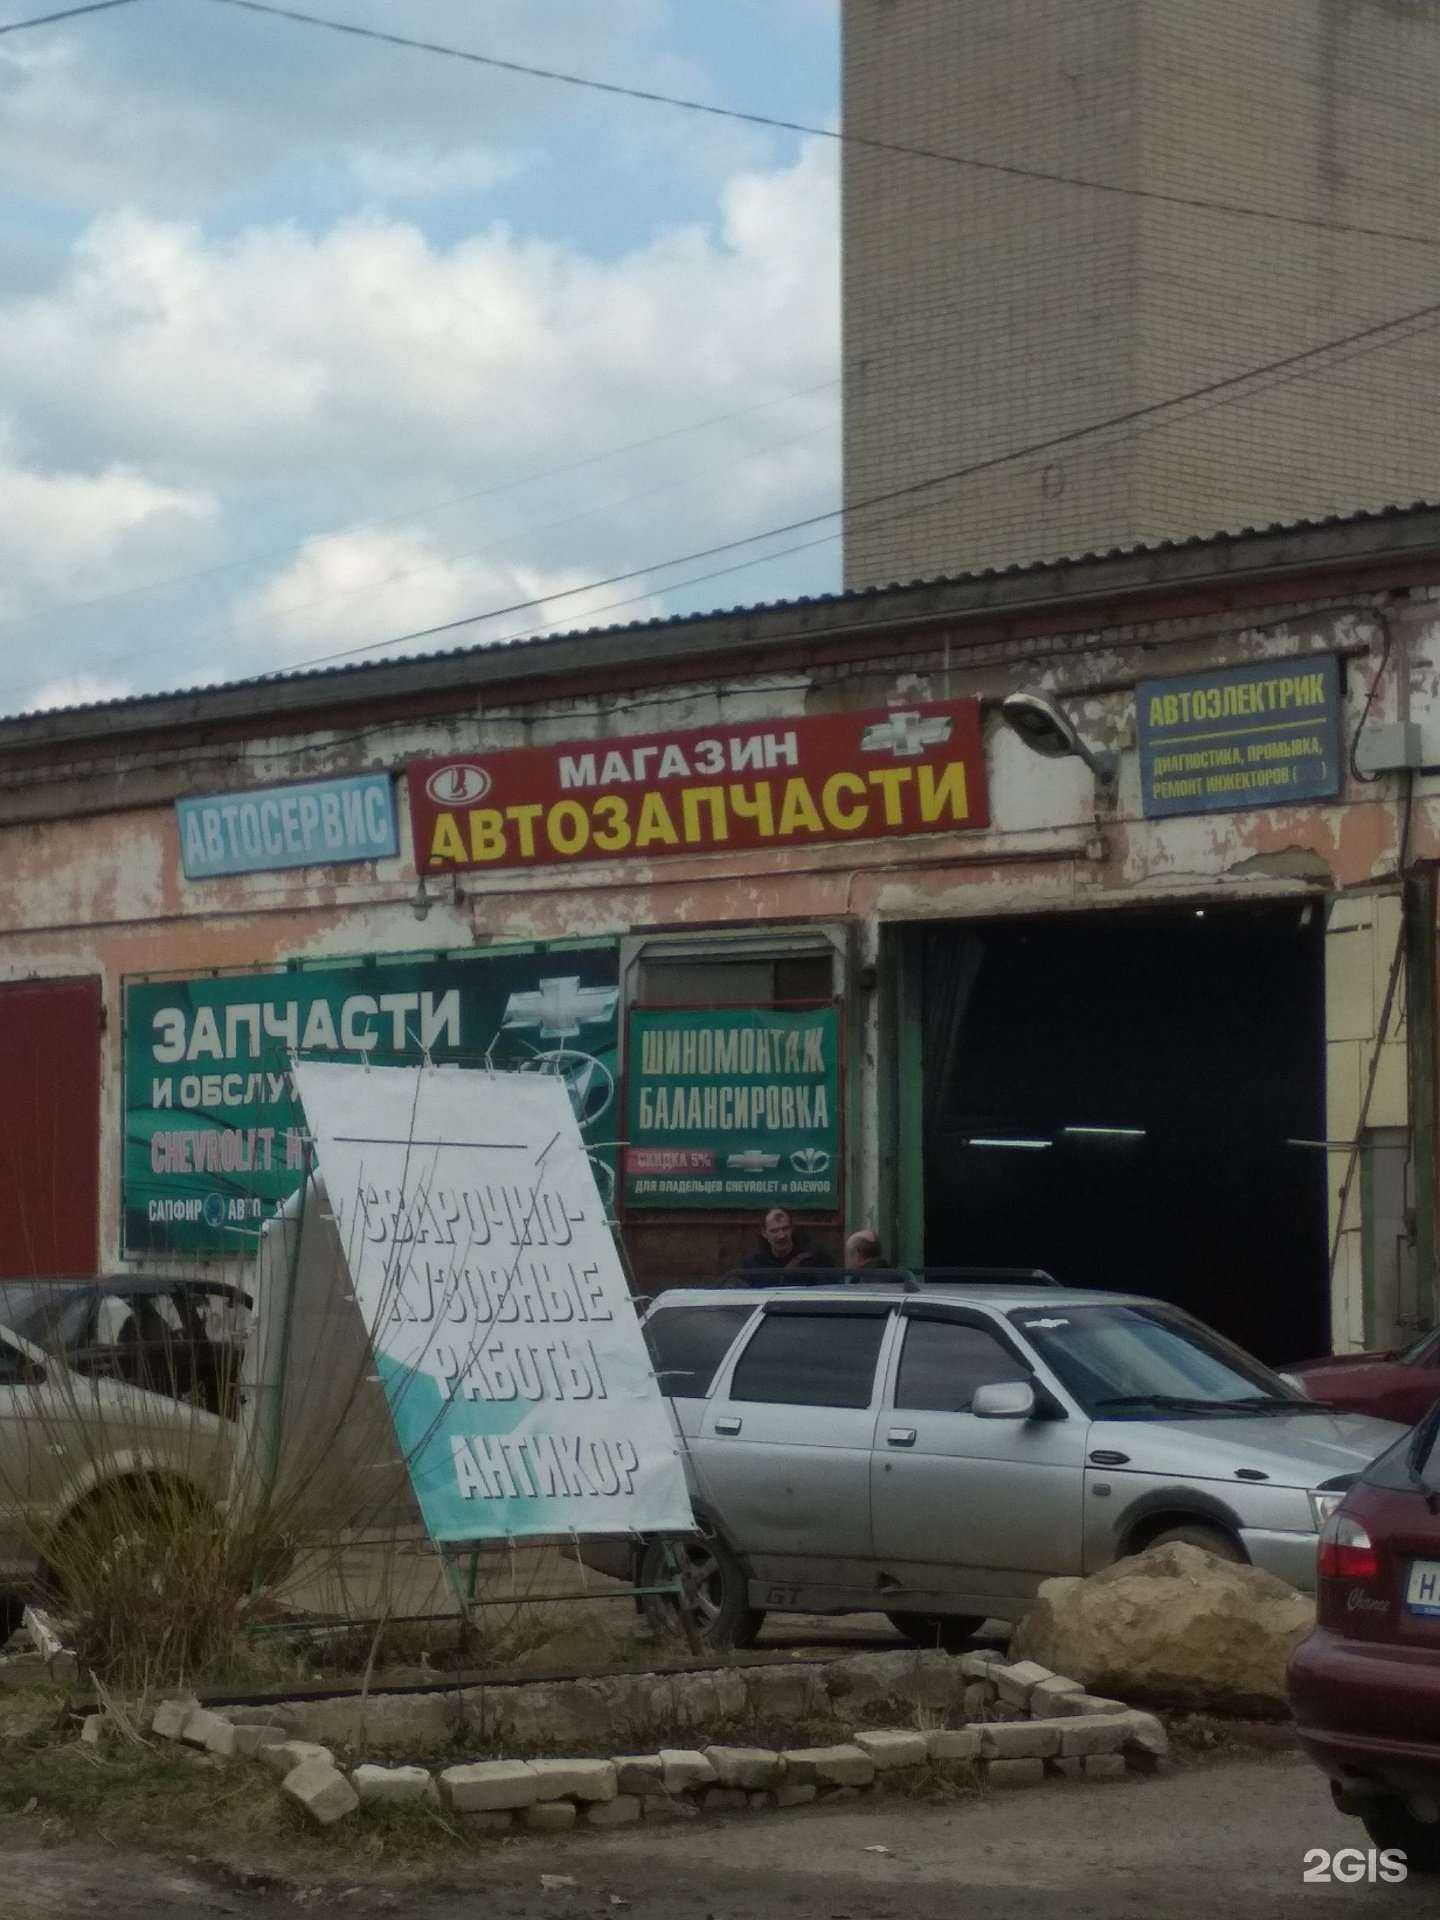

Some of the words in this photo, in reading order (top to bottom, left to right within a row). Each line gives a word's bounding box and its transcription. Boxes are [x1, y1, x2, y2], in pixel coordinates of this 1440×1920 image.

[1150, 673, 1325, 727] АВТОЭЛЕКТРИК
[559, 731, 798, 789] МАГАЗИН
[429, 761, 970, 866] АВТОЗАПЧАСТИ
[1153, 777, 1202, 800] РЕМОНТ
[184, 787, 389, 865] АВТОСЕРВИС
[151, 989, 462, 1064] ЗАПЧАСТИ
[641, 1027, 825, 1075] ШИНОМОНТАЖ
[153, 1076, 172, 1108] И
[639, 1085, 829, 1130] БАЛАНСИРОВКА
[151, 1127, 275, 1174] CHEVROLET
[148, 1198, 201, 1222] САПФИР
[381, 1261, 613, 1323] КУЗОВНЫЕ
[434, 1337, 608, 1400] РАБОТЫ
[450, 1434, 640, 1499] АНТИКОР
